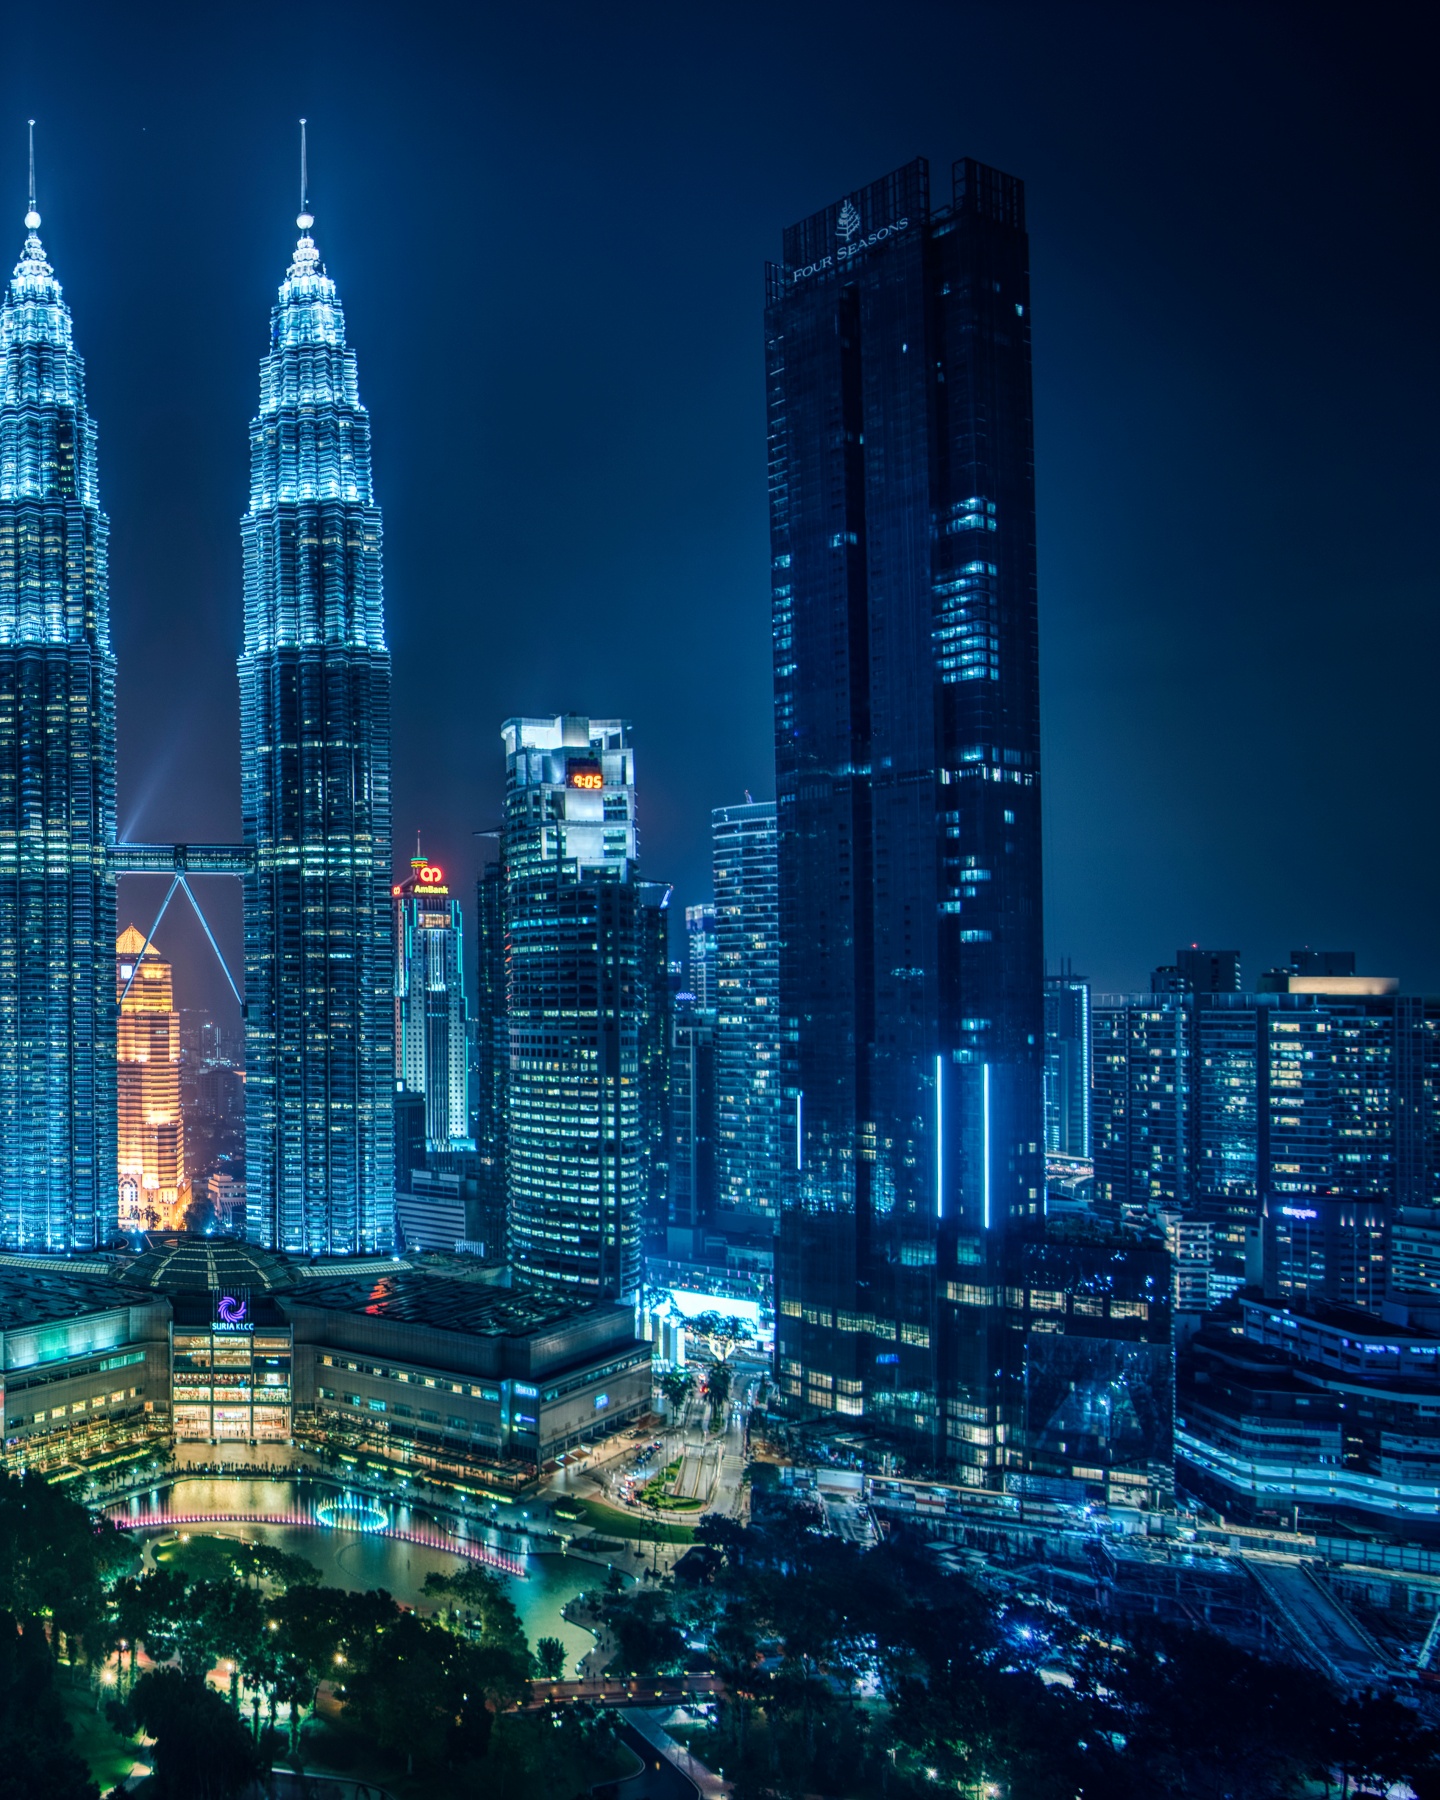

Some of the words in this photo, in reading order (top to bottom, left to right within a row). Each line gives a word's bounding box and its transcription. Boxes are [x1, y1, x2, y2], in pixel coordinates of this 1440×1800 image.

[793, 255, 833, 283] FOUR
[836, 217, 909, 261] SEASONS
[573, 775, 602, 789] 9:05
[413, 884, 449, 895] AmBank
[212, 1322, 235, 1331] SURIA
[235, 1323, 255, 1331] KLCC
